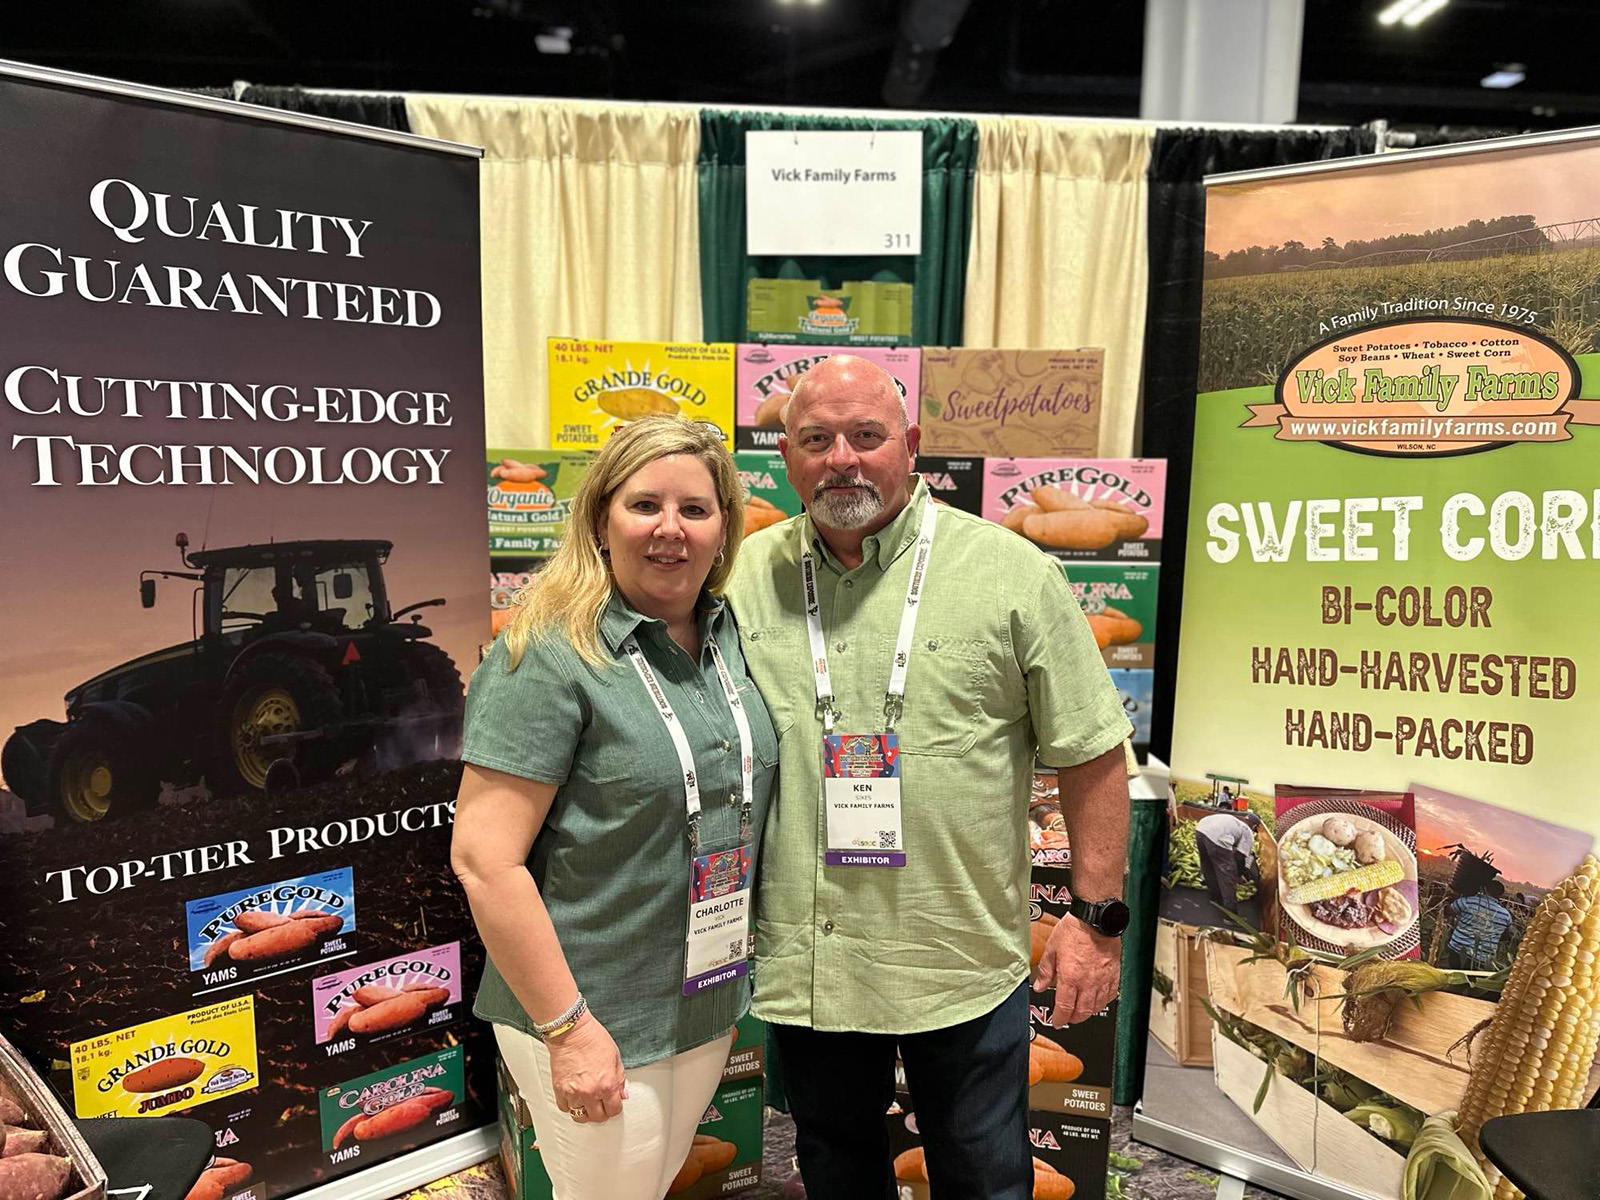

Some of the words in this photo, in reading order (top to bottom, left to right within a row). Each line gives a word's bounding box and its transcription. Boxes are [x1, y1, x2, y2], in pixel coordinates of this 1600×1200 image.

[771, 169, 801, 181] Vick
[805, 169, 851, 184] Family
[855, 169, 896, 181] Farms
[90, 178, 374, 258] QUALITY
[884, 234, 911, 249] 311
[3, 242, 443, 329] GUARANTEED
[1318, 323, 1329, 334] A
[1331, 307, 1379, 331] Family
[1381, 297, 1449, 316] Tradition
[1453, 297, 1496, 314] Since
[1499, 302, 1538, 324] 1975
[554, 343, 569, 352] 40
[595, 345, 614, 353] NET
[665, 346, 698, 354] PRODUCT
[1333, 343, 1363, 353] Sweet
[1366, 341, 1411, 352] Potatoes
[1422, 339, 1468, 349] Tobacco
[1480, 337, 1520, 347] Cotton
[1338, 354, 1358, 364] Soy
[1359, 352, 1391, 362] Beans
[1401, 350, 1436, 360] Wheat
[1446, 349, 1480, 359] Sweet
[1483, 348, 1512, 358] Corn
[4, 365, 453, 427] CUTTING-EDGE
[574, 371, 652, 402] GRANDE
[657, 374, 706, 407] GOLD
[1294, 365, 1357, 405] Vick
[1361, 364, 1459, 412] Family
[1464, 364, 1560, 402] Farms
[942, 382, 1094, 427] Sweetpotatoes
[563, 424, 592, 433] SWEET
[1289, 418, 1558, 438] www.vickfamilyfarms.com
[557, 433, 599, 444] POTATOES
[1396, 442, 1425, 451] WILSON,
[12, 434, 452, 486] TECHNOLOGY
[999, 467, 1152, 509] PUREGOLD
[488, 487, 553, 512] Organic
[1206, 495, 1424, 563] SWEET
[1438, 489, 1600, 562] COR
[495, 538, 538, 551] Family
[1321, 585, 1493, 628] BI-COLOR
[1251, 646, 1577, 700] HAND-HARVESTED
[1284, 708, 1535, 766] HAND-PACKED
[853, 784, 873, 792] KEN
[841, 856, 890, 864] EXHIBITOR
[46, 839, 253, 904] TOP-TIER
[199, 885, 345, 943] PUREGOLD
[695, 897, 744, 919] CHARLOTTE
[694, 926, 707, 935] VICK
[708, 921, 726, 931] FAMILY
[727, 915, 743, 926] FARMS
[320, 942, 347, 956] POTATOES
[323, 938, 343, 950] SWEET
[202, 966, 238, 986] YAMS
[697, 969, 737, 989] EXHIBITOR
[324, 960, 452, 1016] PUREGOLD
[187, 1006, 219, 1020] PRODUCT
[220, 1003, 230, 1012] OF
[231, 999, 250, 1010] U.S.A.
[432, 1008, 449, 1020] SWEET
[74, 1044, 88, 1054] 40
[91, 1038, 113, 1050] LBS.
[116, 1030, 136, 1043] NET
[325, 1038, 356, 1057] YAMS
[75, 1053, 96, 1065] 18.1
[98, 1049, 113, 1061] kg.
[97, 1042, 177, 1093] GRANDE
[180, 1038, 231, 1059] GOLD
[730, 1051, 754, 1064] SWEET
[723, 1060, 760, 1076] POTATOES
[338, 1062, 447, 1109] CAROLINA
[1071, 1088, 1100, 1101] SWEET
[138, 1087, 195, 1114] JUMBO
[362, 1082, 426, 1116] GOLD
[1064, 1098, 1106, 1111] POTATOES
[1061, 1124, 1083, 1133] PRODUCE
[330, 1145, 360, 1165] YAMS
[729, 1166, 753, 1180] SWEET
[722, 1175, 759, 1192] POTATOES
